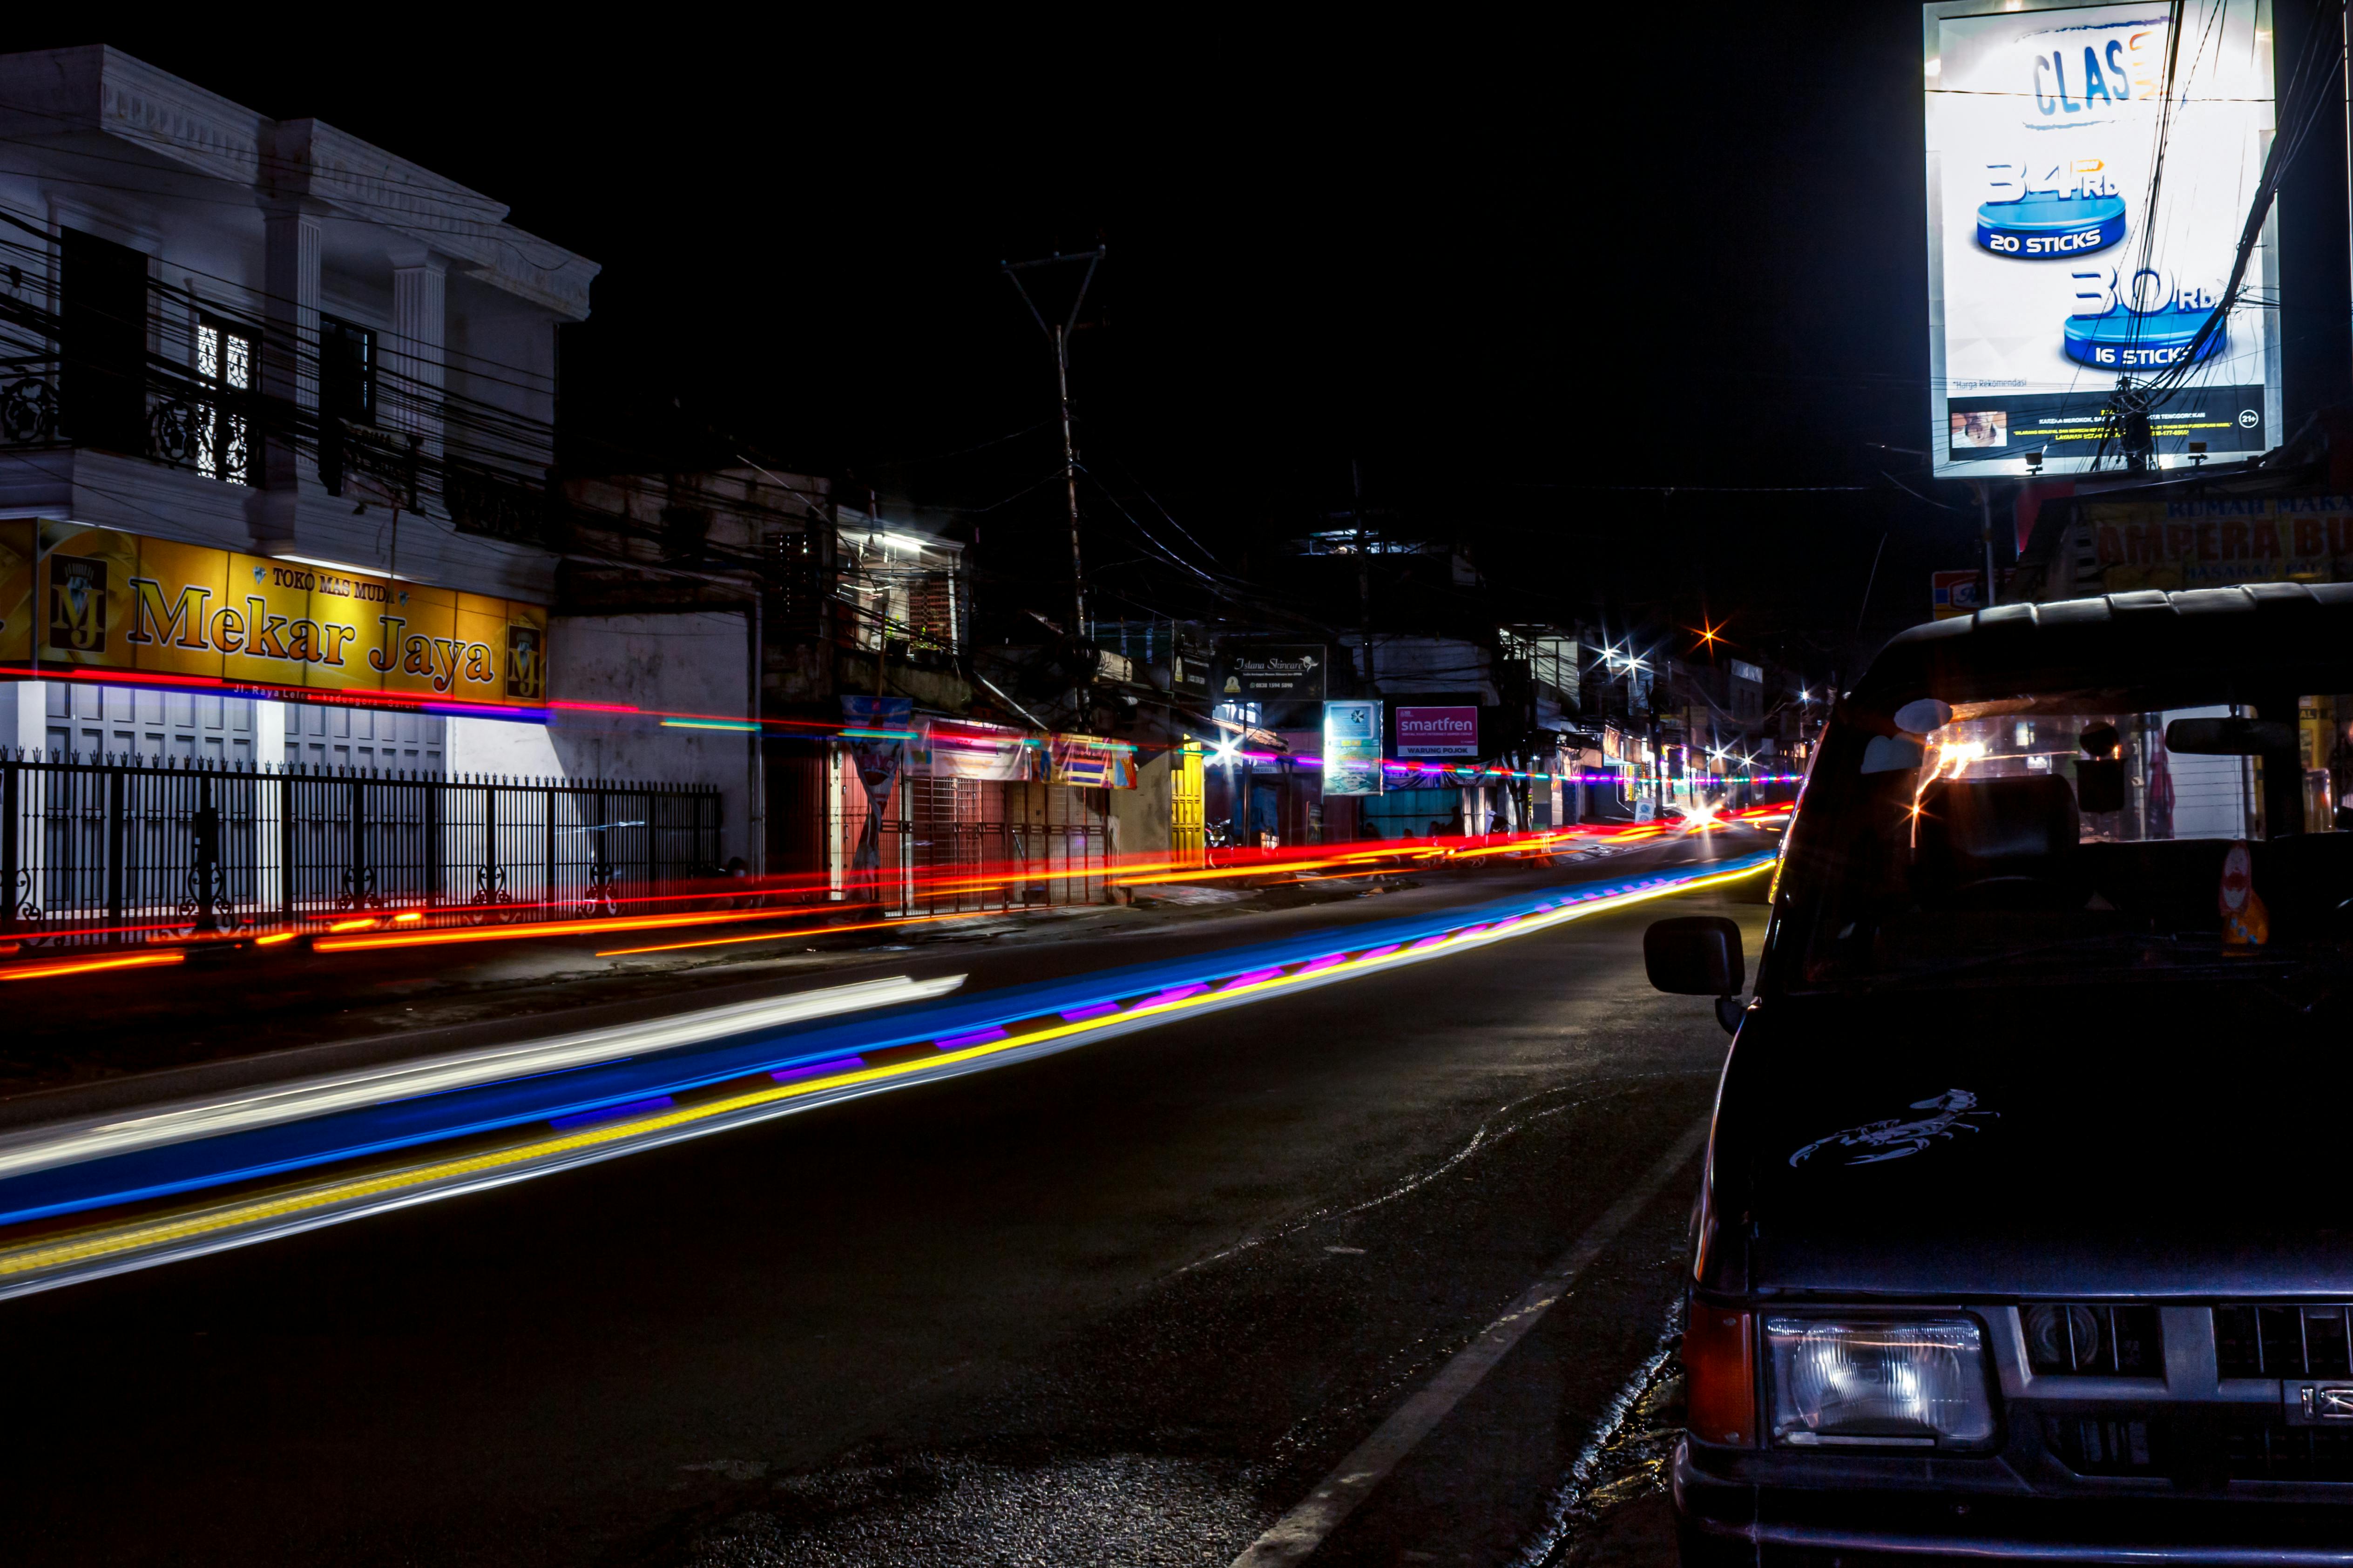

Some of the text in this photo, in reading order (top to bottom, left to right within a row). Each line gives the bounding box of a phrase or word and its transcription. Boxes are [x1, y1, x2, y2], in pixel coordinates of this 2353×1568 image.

[1990, 229, 2101, 253] 20 STICKS
[2096, 347, 2116, 364] 16
[1979, 378, 2027, 387] Rekomendasi
[2098, 520, 2280, 564] AMPERA
[273, 567, 315, 592] TOKO
[318, 575, 351, 597] MAS
[127, 577, 494, 693] Mekar Jaya
[1267, 658, 1303, 670] Skincare
[252, 686, 279, 698] Raya
[283, 689, 312, 700] Leles
[1401, 717, 1473, 731] smartfren
